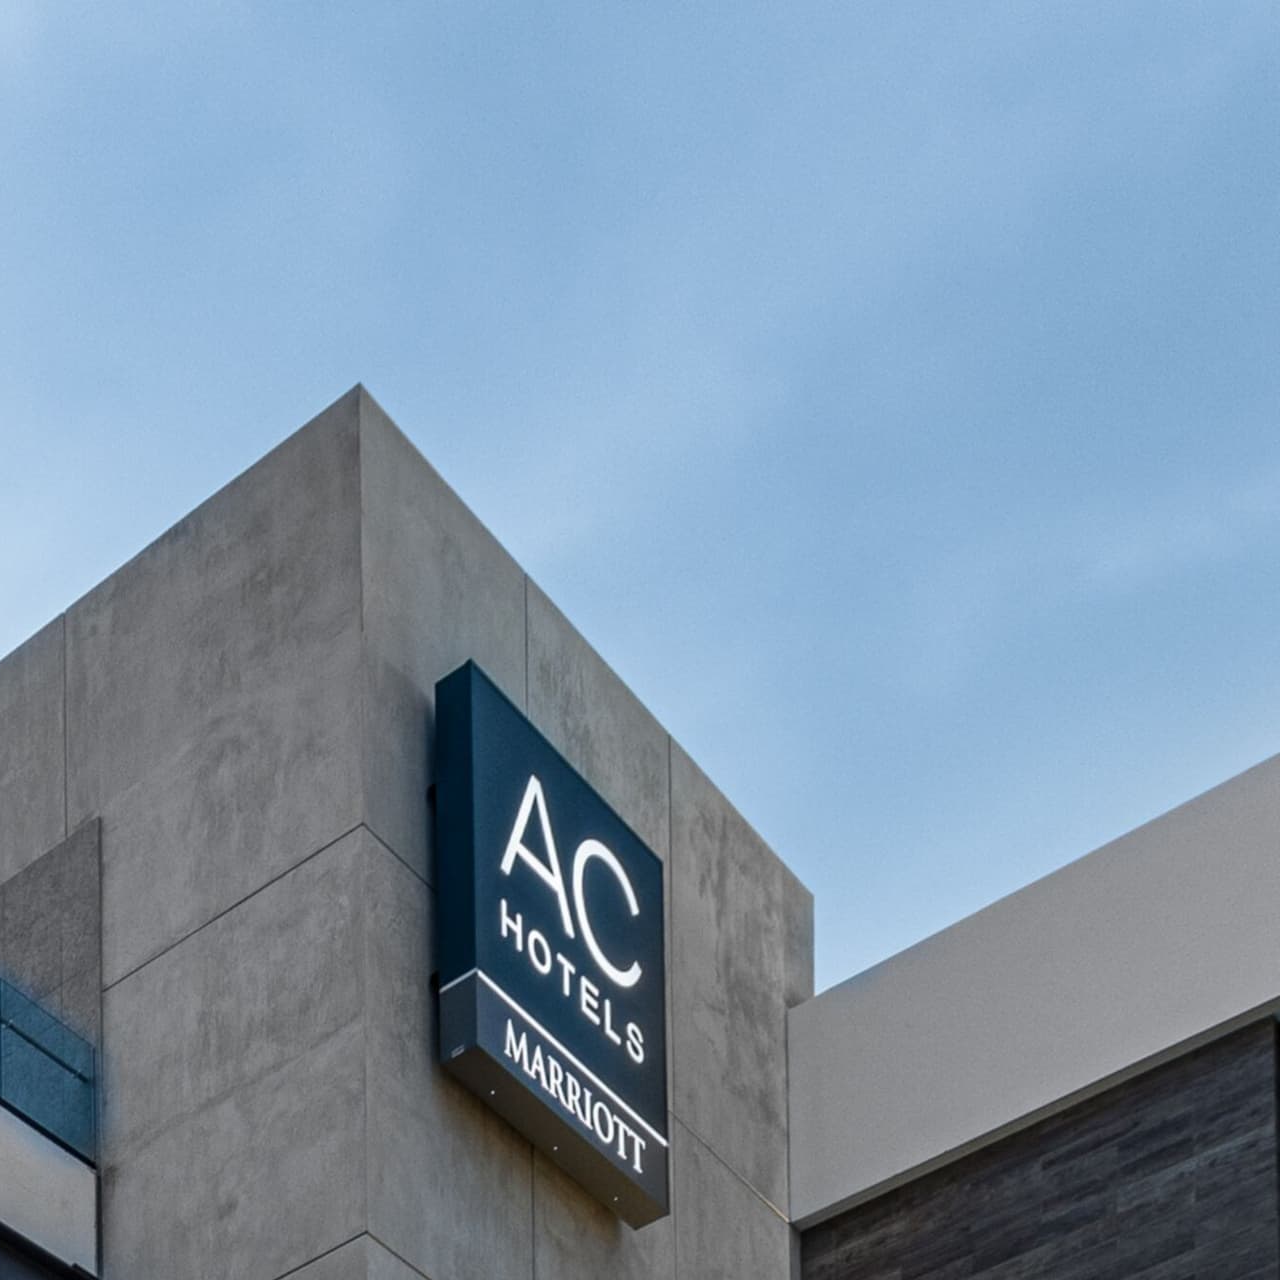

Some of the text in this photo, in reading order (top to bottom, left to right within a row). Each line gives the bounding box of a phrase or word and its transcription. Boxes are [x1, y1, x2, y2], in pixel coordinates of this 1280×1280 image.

[499, 774, 643, 989] AC
[500, 898, 645, 1065] HOTELS
[503, 1018, 647, 1175] MARRIOTT
